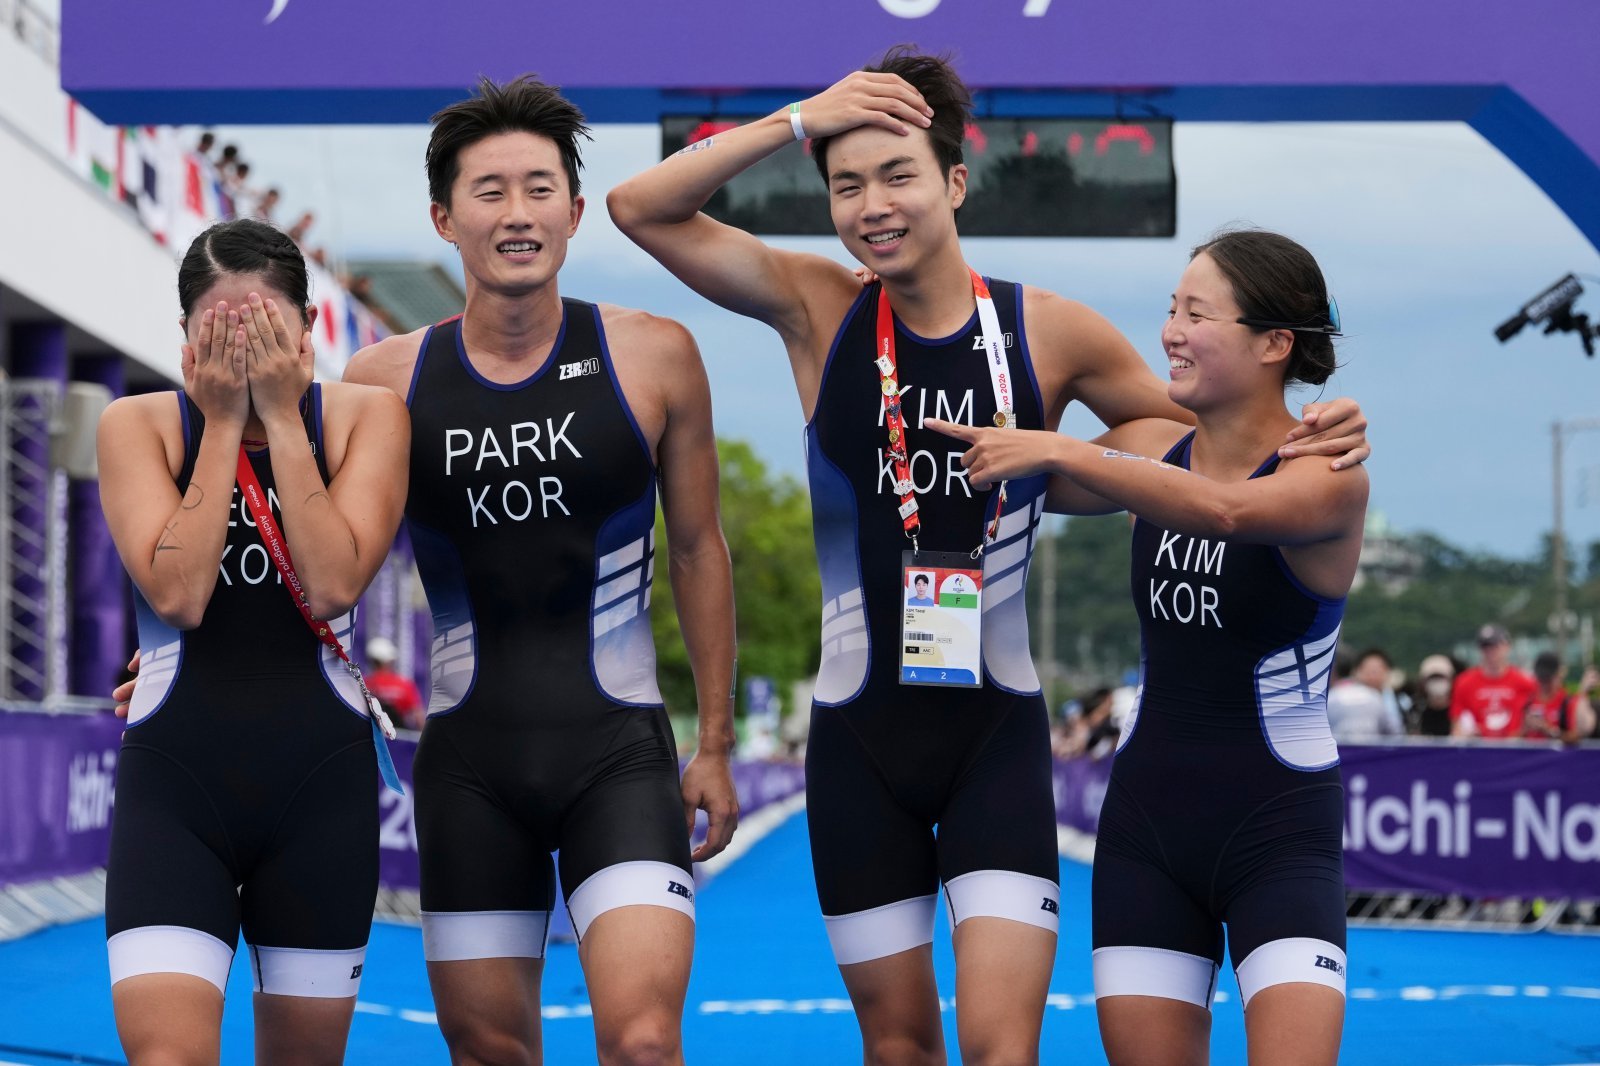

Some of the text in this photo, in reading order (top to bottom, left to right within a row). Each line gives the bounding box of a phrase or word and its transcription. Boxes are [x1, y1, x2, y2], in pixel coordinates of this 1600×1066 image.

[999, 373, 1007, 393] 2026
[445, 411, 583, 476] PARK
[877, 447, 973, 498] KOR
[466, 476, 571, 528] KOR
[259, 514, 301, 592] Aichi-Nagoya 2026
[1154, 530, 1226, 576] KIM
[955, 597, 961, 605] F
[1150, 578, 1223, 628] KOR
[910, 671, 947, 680] A 2
[1343, 774, 1600, 863] ichi-Na
